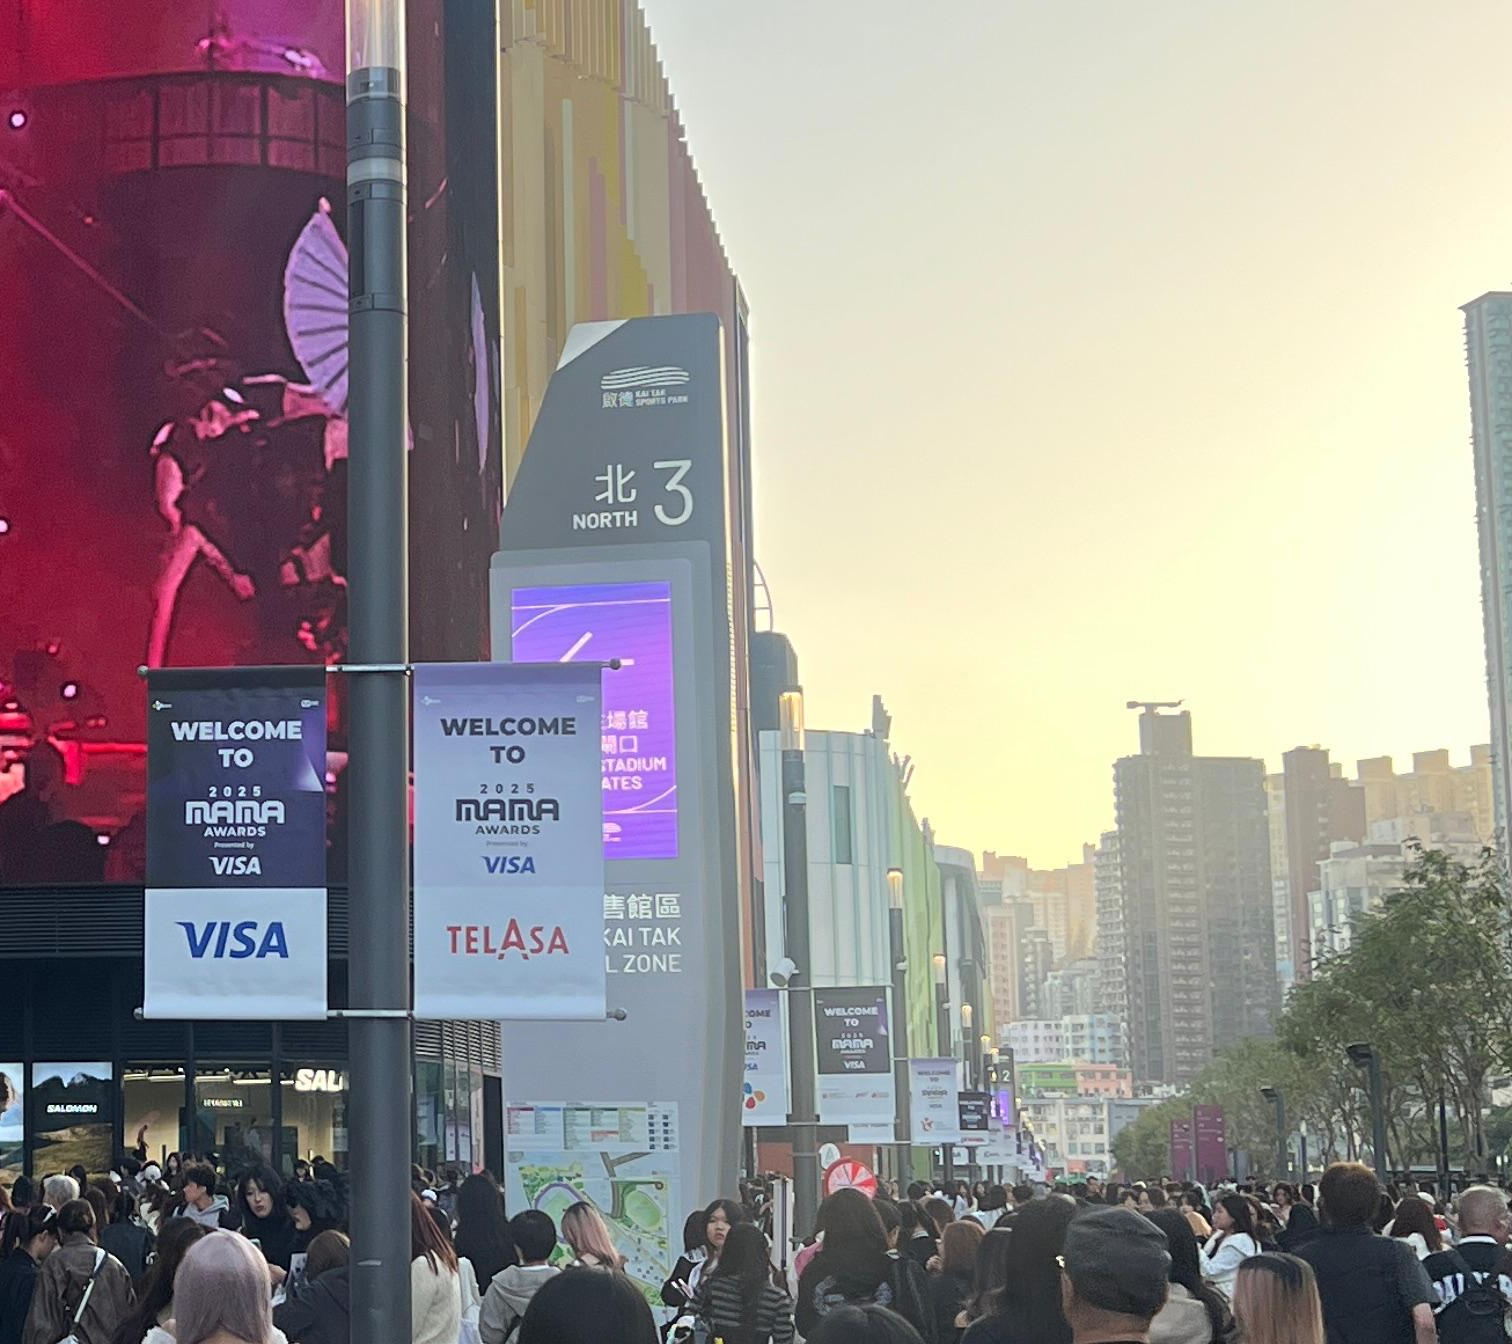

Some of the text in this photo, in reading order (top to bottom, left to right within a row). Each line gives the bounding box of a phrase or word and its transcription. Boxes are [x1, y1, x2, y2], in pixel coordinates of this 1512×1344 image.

[595, 463, 637, 504] 北
[653, 459, 694, 526] 3
[573, 510, 638, 530] NORTH
[171, 720, 302, 741] WELCOME
[440, 717, 576, 736] WELCOME
[218, 748, 254, 768] TO
[490, 745, 526, 764] TO
[208, 786, 262, 798] 2025
[480, 783, 535, 794] 2025
[601, 776, 643, 790] ATES
[185, 800, 286, 825] MAMA
[456, 798, 559, 821] MAMA
[204, 826, 266, 837] AWARDS
[475, 825, 540, 835] AWARDS
[208, 856, 262, 875] VISA
[481, 856, 535, 874] VISA
[603, 894, 681, 919] 售館區
[174, 921, 289, 958] VISA
[446, 918, 569, 960] TELASA
[638, 928, 681, 946] TAK
[623, 955, 682, 973] ZONE
[824, 1007, 878, 1017] WELCOME
[844, 1018, 859, 1027] TO
[844, 1060, 866, 1069] VISA
[1002, 1070, 1011, 1082] 2
[46, 1104, 98, 1114] SALOMON
